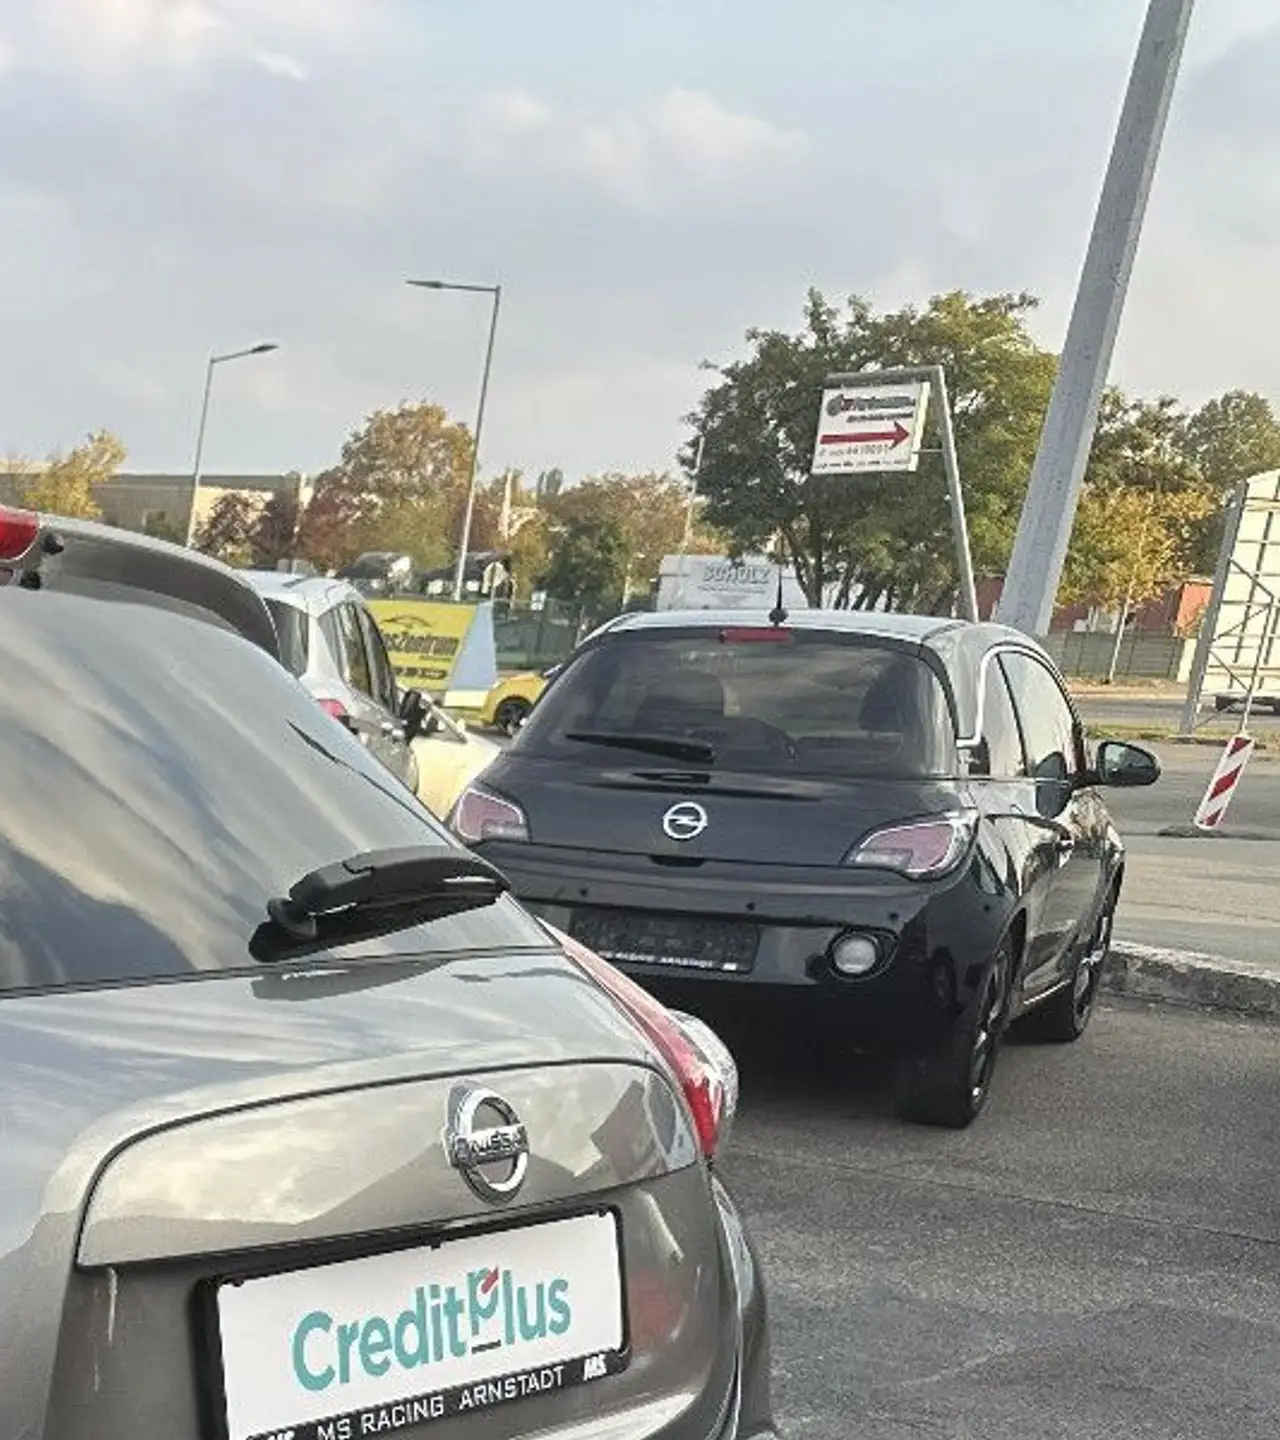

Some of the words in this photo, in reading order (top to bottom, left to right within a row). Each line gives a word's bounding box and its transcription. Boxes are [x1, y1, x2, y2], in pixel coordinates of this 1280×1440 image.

[292, 1267, 572, 1392] CreditPlus
[361, 1396, 445, 1434] RACING
[458, 1365, 566, 1411] ARNSTADT
